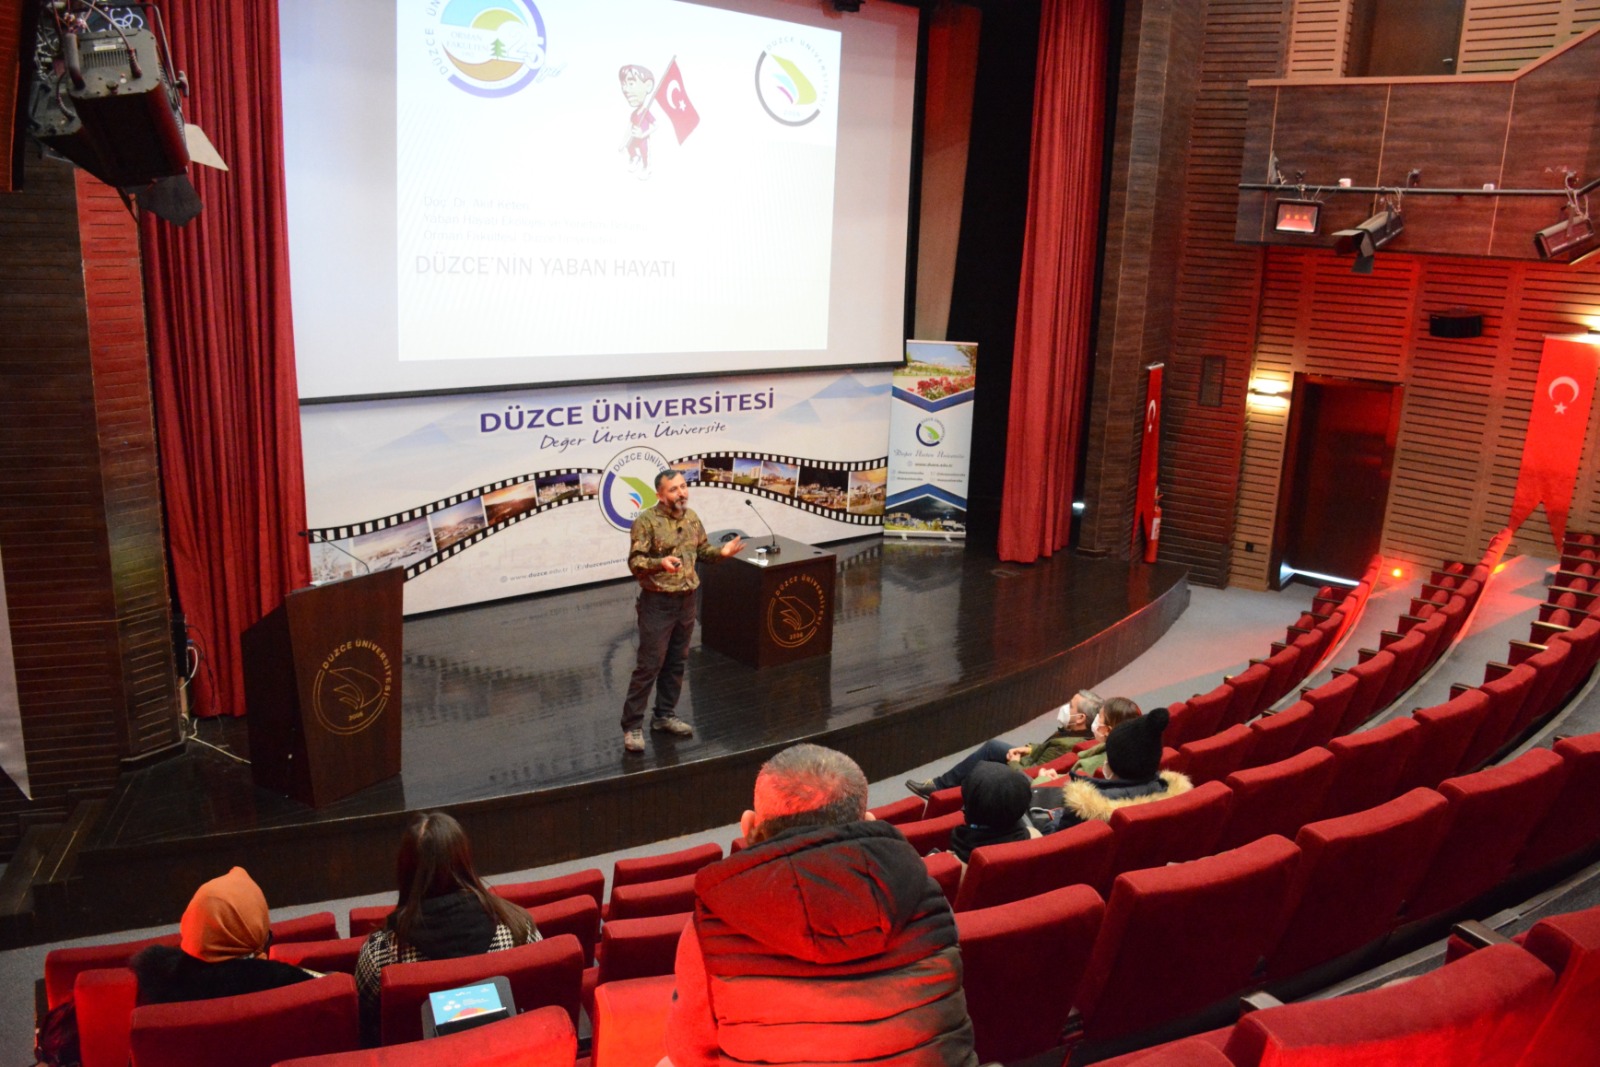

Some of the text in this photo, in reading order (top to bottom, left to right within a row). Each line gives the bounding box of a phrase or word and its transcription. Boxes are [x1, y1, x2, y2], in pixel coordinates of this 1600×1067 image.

[540, 257, 606, 277] YABAN
[613, 259, 676, 278] HAYATI
[480, 387, 774, 433] DÜZCE ÜNİVERSİTESİ
[539, 420, 727, 453] Değer Üreten Üniversite
[613, 451, 667, 473] DÜZCE ÜNİVE
[322, 640, 353, 669] DÜZCE
